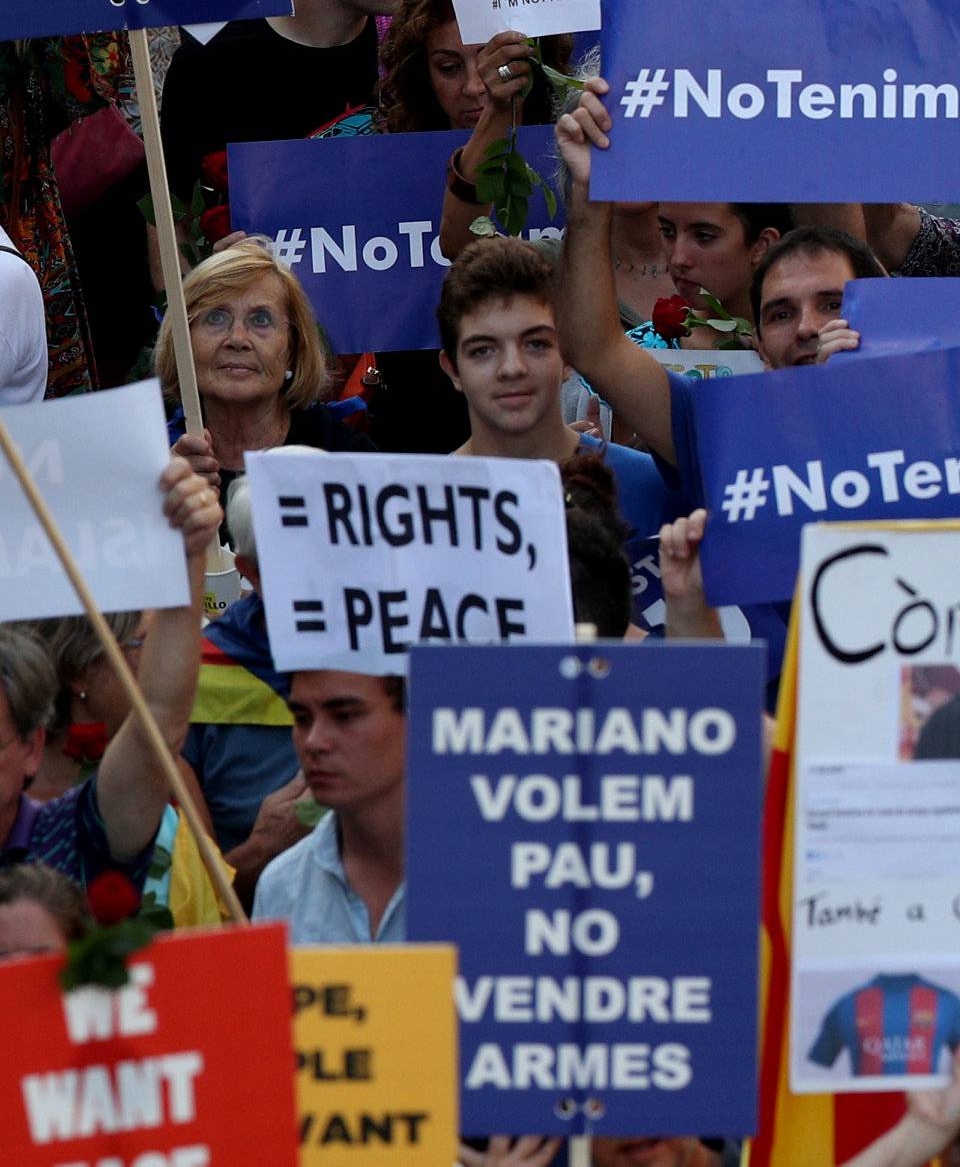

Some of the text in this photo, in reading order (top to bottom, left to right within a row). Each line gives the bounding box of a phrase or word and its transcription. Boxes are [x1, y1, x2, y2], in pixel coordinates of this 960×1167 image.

[619, 68, 959, 120] #NoTenim
[323, 482, 537, 571] RIGHTS,
[431, 707, 737, 756] MARIANO
[470, 774, 693, 822] VOLEM
[511, 841, 654, 899] PAU,
[525, 908, 621, 957] NO
[62, 962, 158, 1046] WE
[453, 975, 712, 1023] VENDRE
[465, 1042, 692, 1090] ARMES
[22, 1051, 204, 1145] WANT
